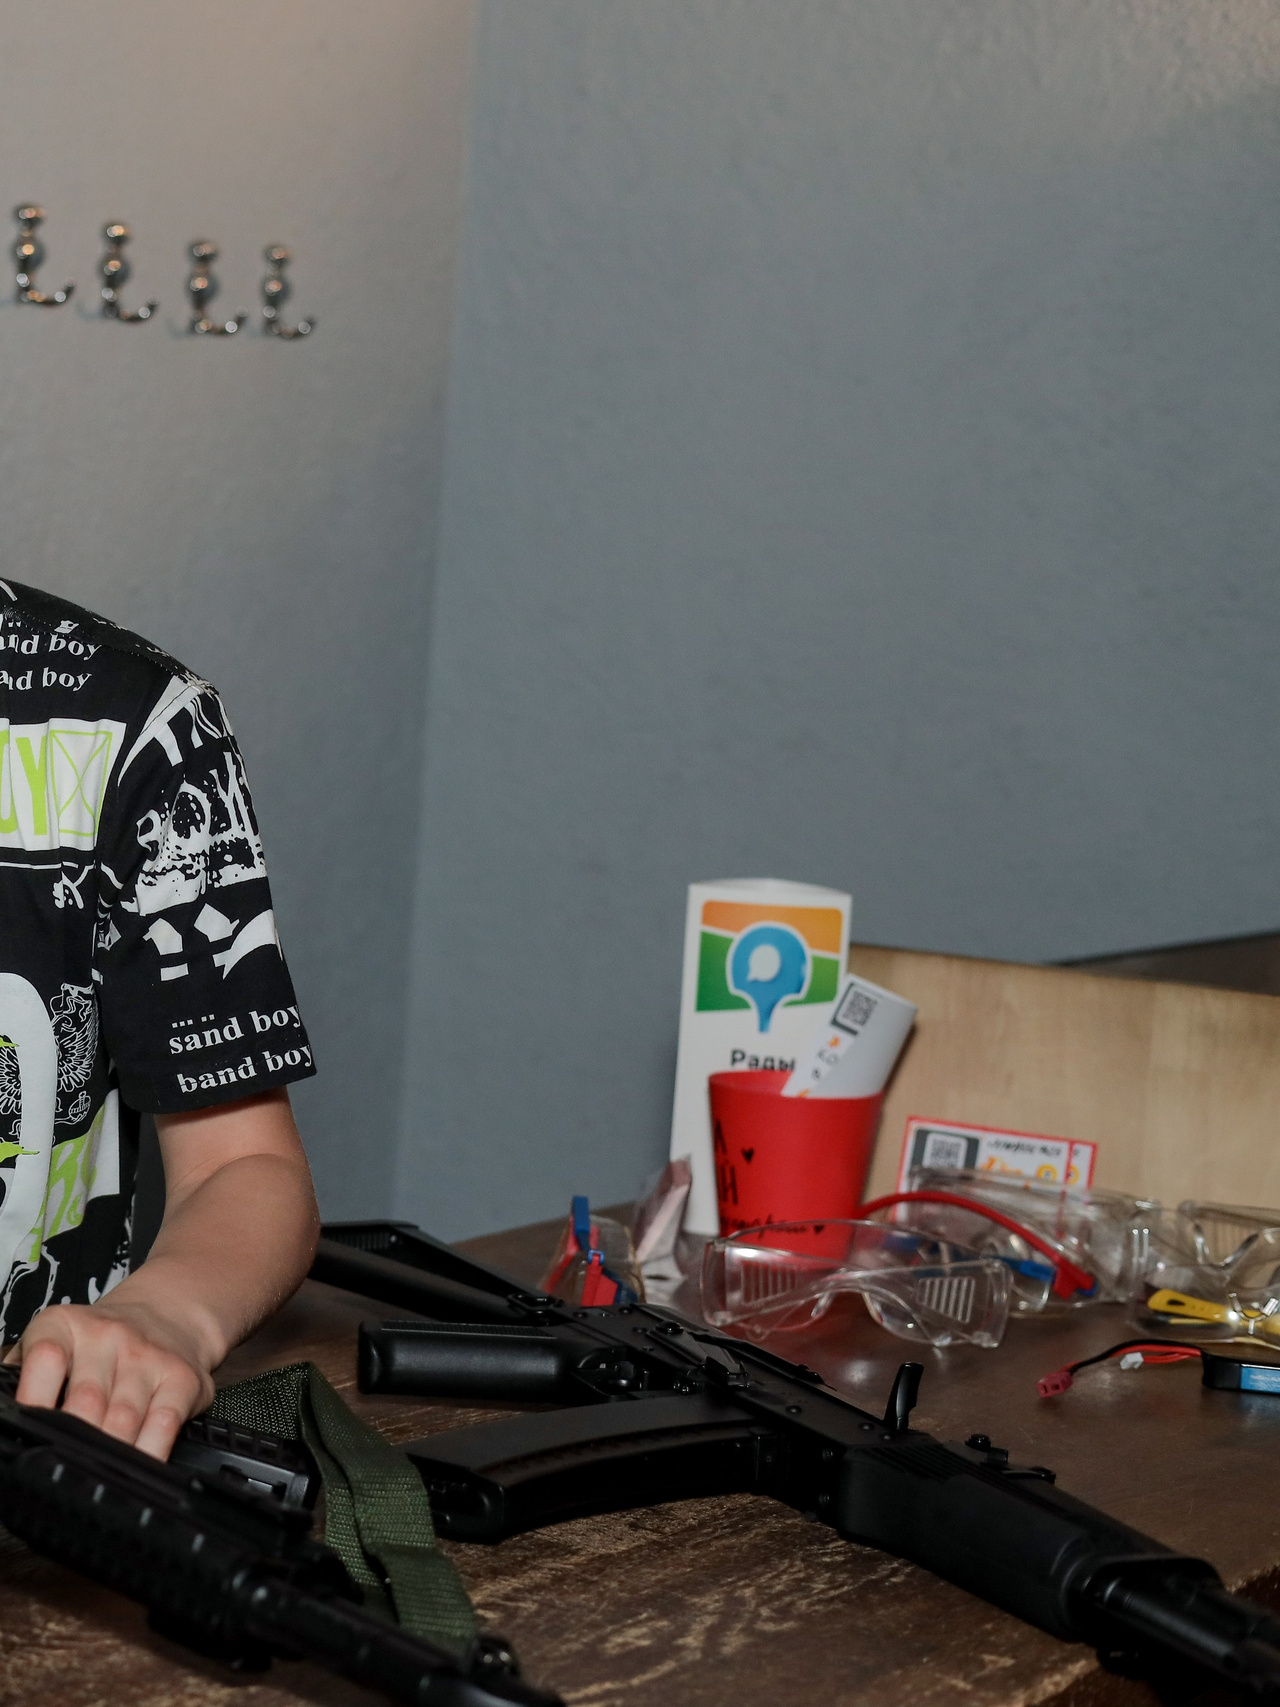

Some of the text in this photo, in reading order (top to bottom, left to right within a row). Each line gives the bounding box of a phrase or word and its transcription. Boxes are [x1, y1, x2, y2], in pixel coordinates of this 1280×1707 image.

[48, 632, 102, 661] boy
[42, 666, 93, 692] boy
[169, 1004, 301, 1055] sand boy
[176, 1044, 313, 1094] band boy
[730, 1048, 796, 1071] Рады
